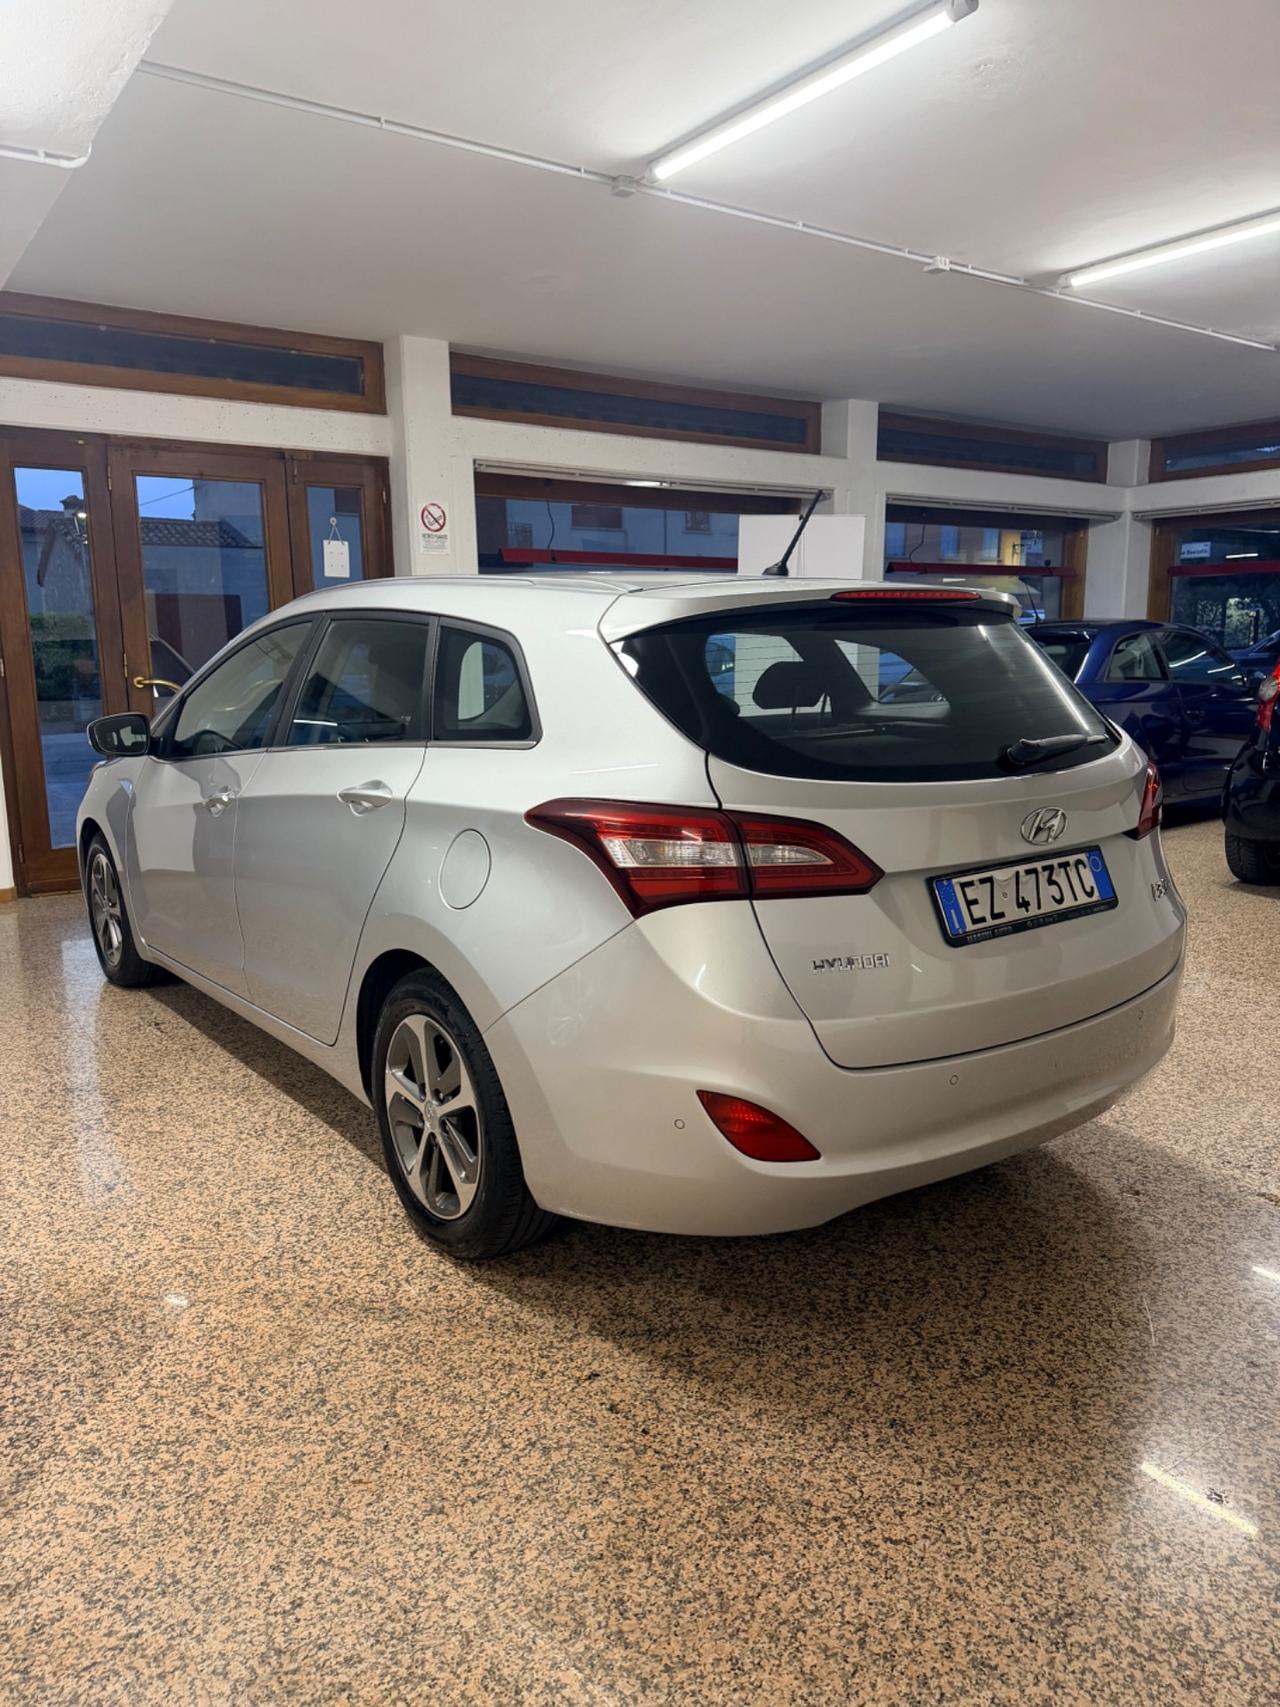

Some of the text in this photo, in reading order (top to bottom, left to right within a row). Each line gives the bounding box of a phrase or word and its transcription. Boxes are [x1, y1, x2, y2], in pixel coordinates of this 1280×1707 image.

[959, 858, 1095, 925] EZ 473TC
[812, 953, 889, 974] HYUNDAI
